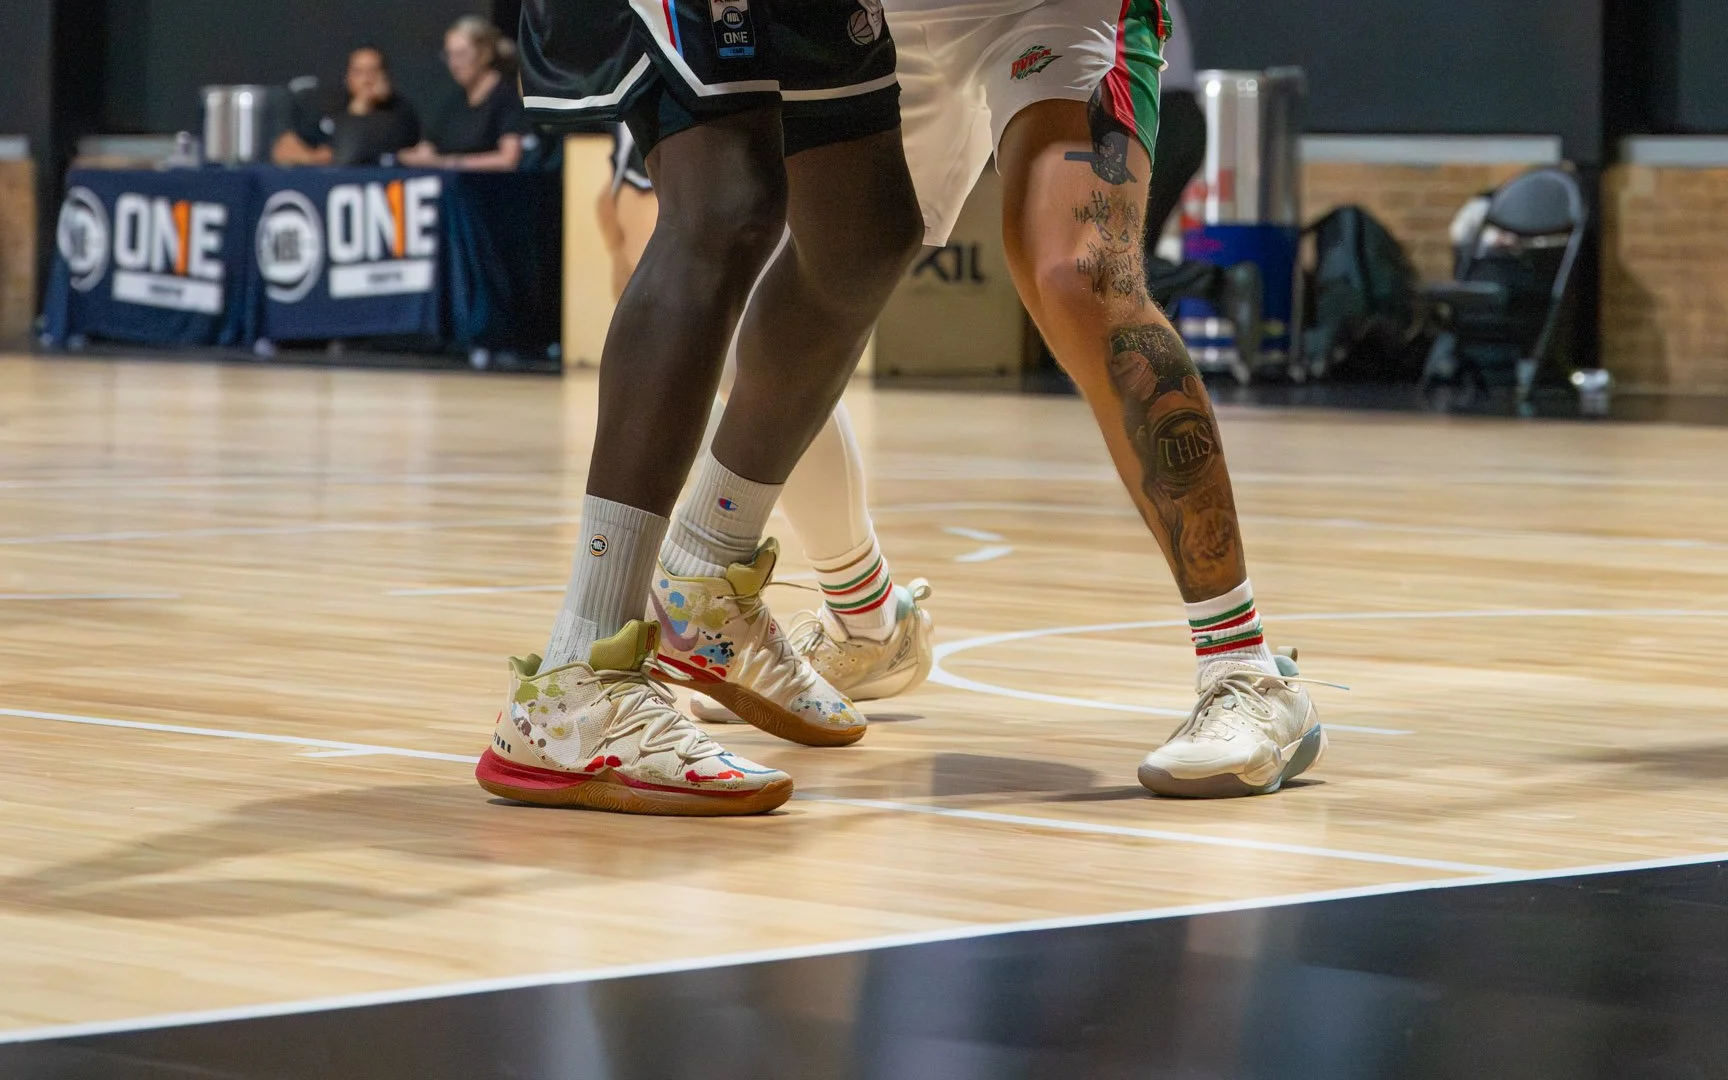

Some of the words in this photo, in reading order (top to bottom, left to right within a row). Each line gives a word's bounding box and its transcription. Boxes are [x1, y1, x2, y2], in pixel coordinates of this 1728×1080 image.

[723, 31, 749, 44] ONE
[114, 191, 228, 280] ONE
[327, 174, 442, 264] ONE
